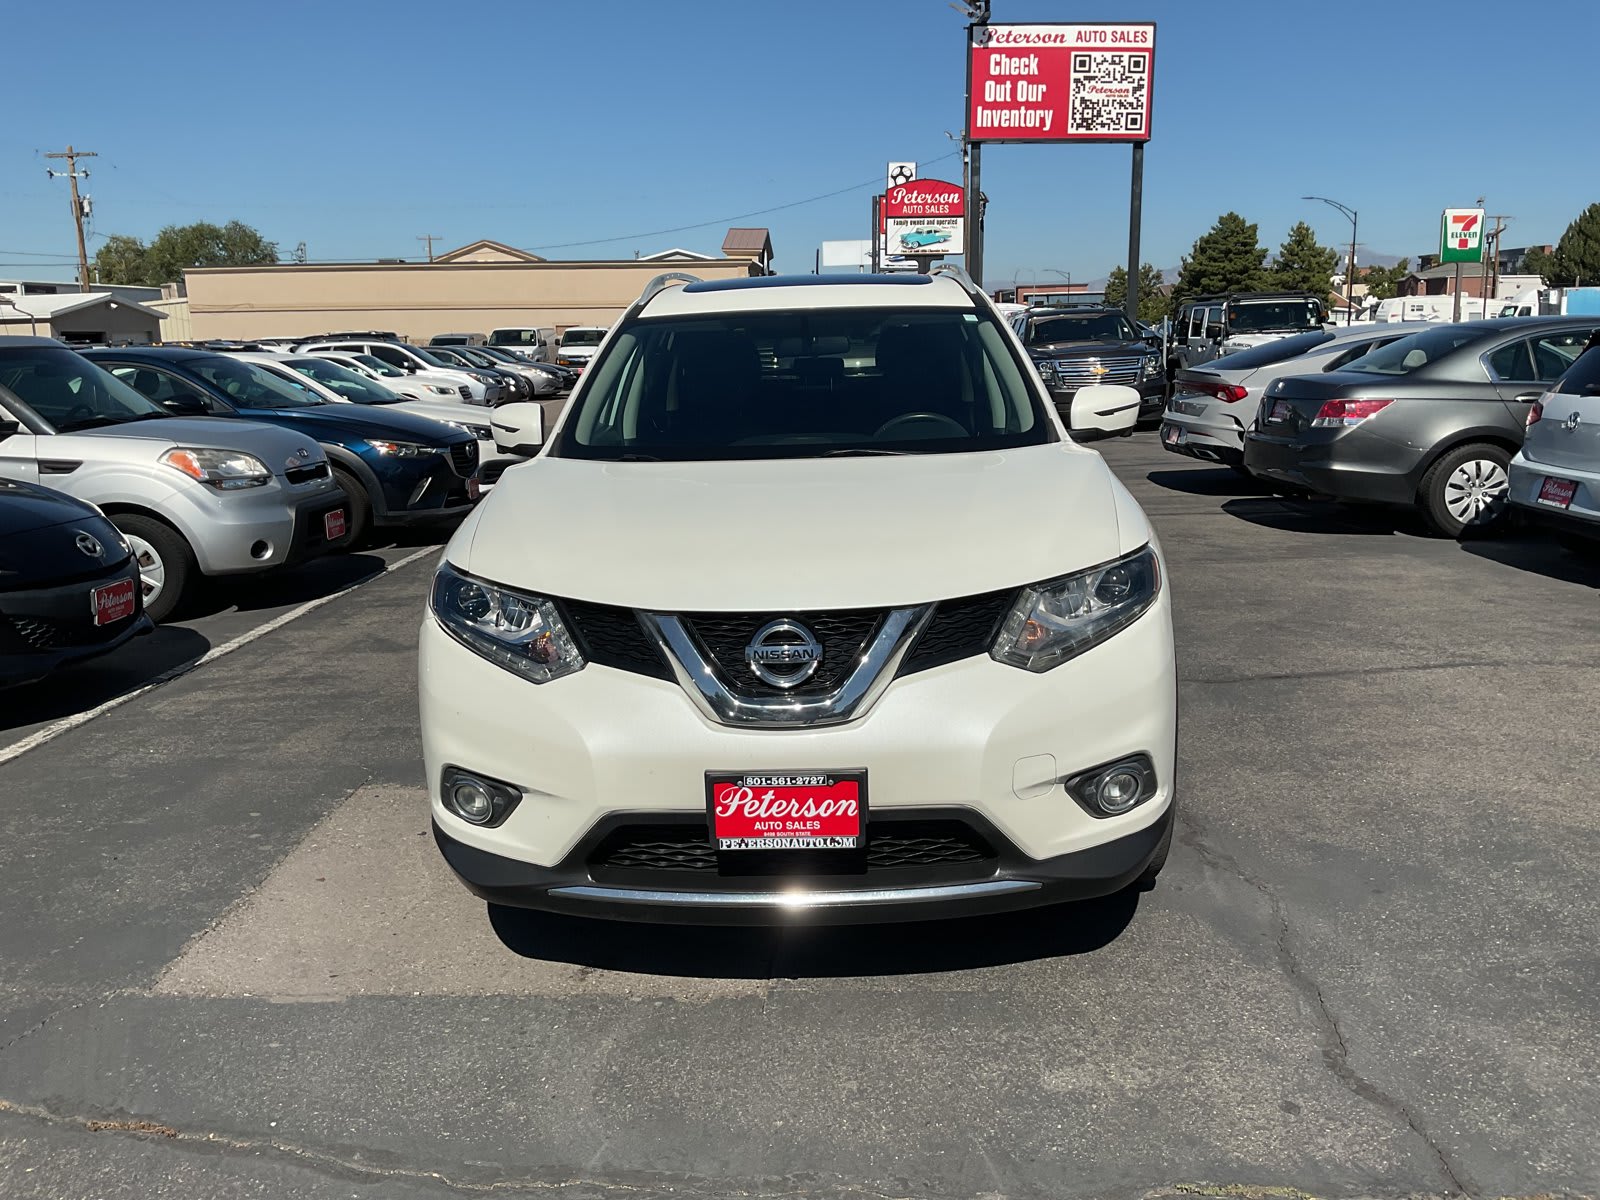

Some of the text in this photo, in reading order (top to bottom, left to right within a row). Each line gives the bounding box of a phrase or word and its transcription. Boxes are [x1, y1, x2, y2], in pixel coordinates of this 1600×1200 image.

[979, 27, 1148, 44] Peterson AUTO SALES
[989, 53, 1039, 76] Check
[985, 80, 1047, 102] Out Our
[1087, 85, 1130, 94] Peterson
[976, 105, 1053, 131] Inventory
[891, 187, 960, 204] Peterson
[902, 205, 949, 214] AUTO SALES
[1452, 214, 1478, 249] 7
[753, 648, 814, 660] NISSAN
[746, 776, 825, 786] 801-561-2727
[716, 786, 858, 818] Peterson
[754, 820, 821, 830] AUTO SALES
